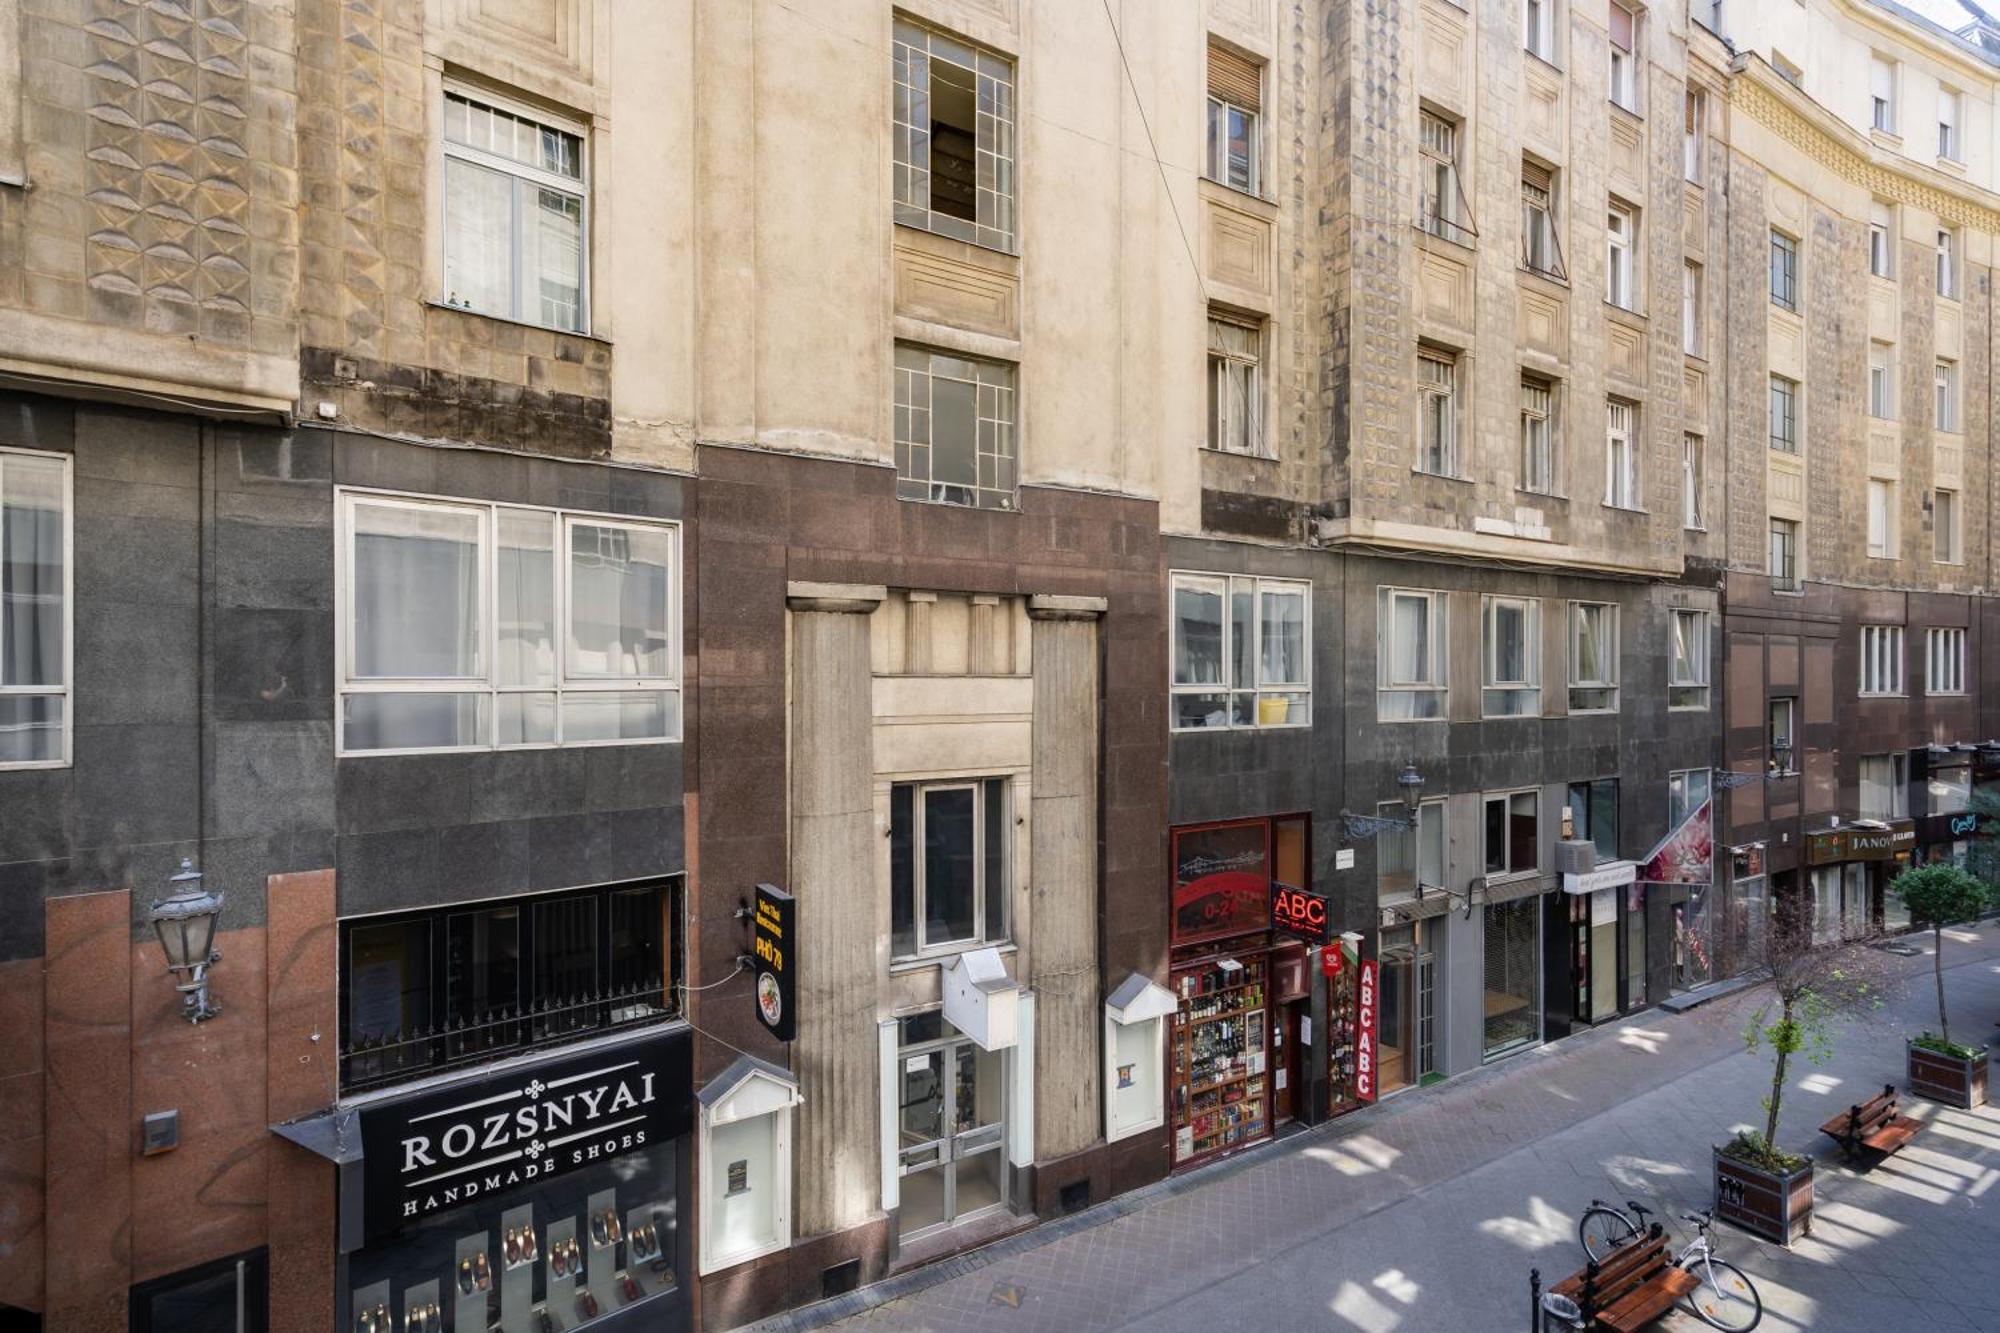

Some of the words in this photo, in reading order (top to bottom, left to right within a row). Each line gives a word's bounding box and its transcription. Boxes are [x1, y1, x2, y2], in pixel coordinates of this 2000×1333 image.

[1274, 890, 1325, 924] ABC
[1360, 965, 1374, 1027] ABC
[1358, 1032, 1371, 1094] ABC
[400, 1072, 656, 1173] ROZSNYAI
[403, 1158, 556, 1217] HANDMADE
[572, 1131, 646, 1164] SHOES
